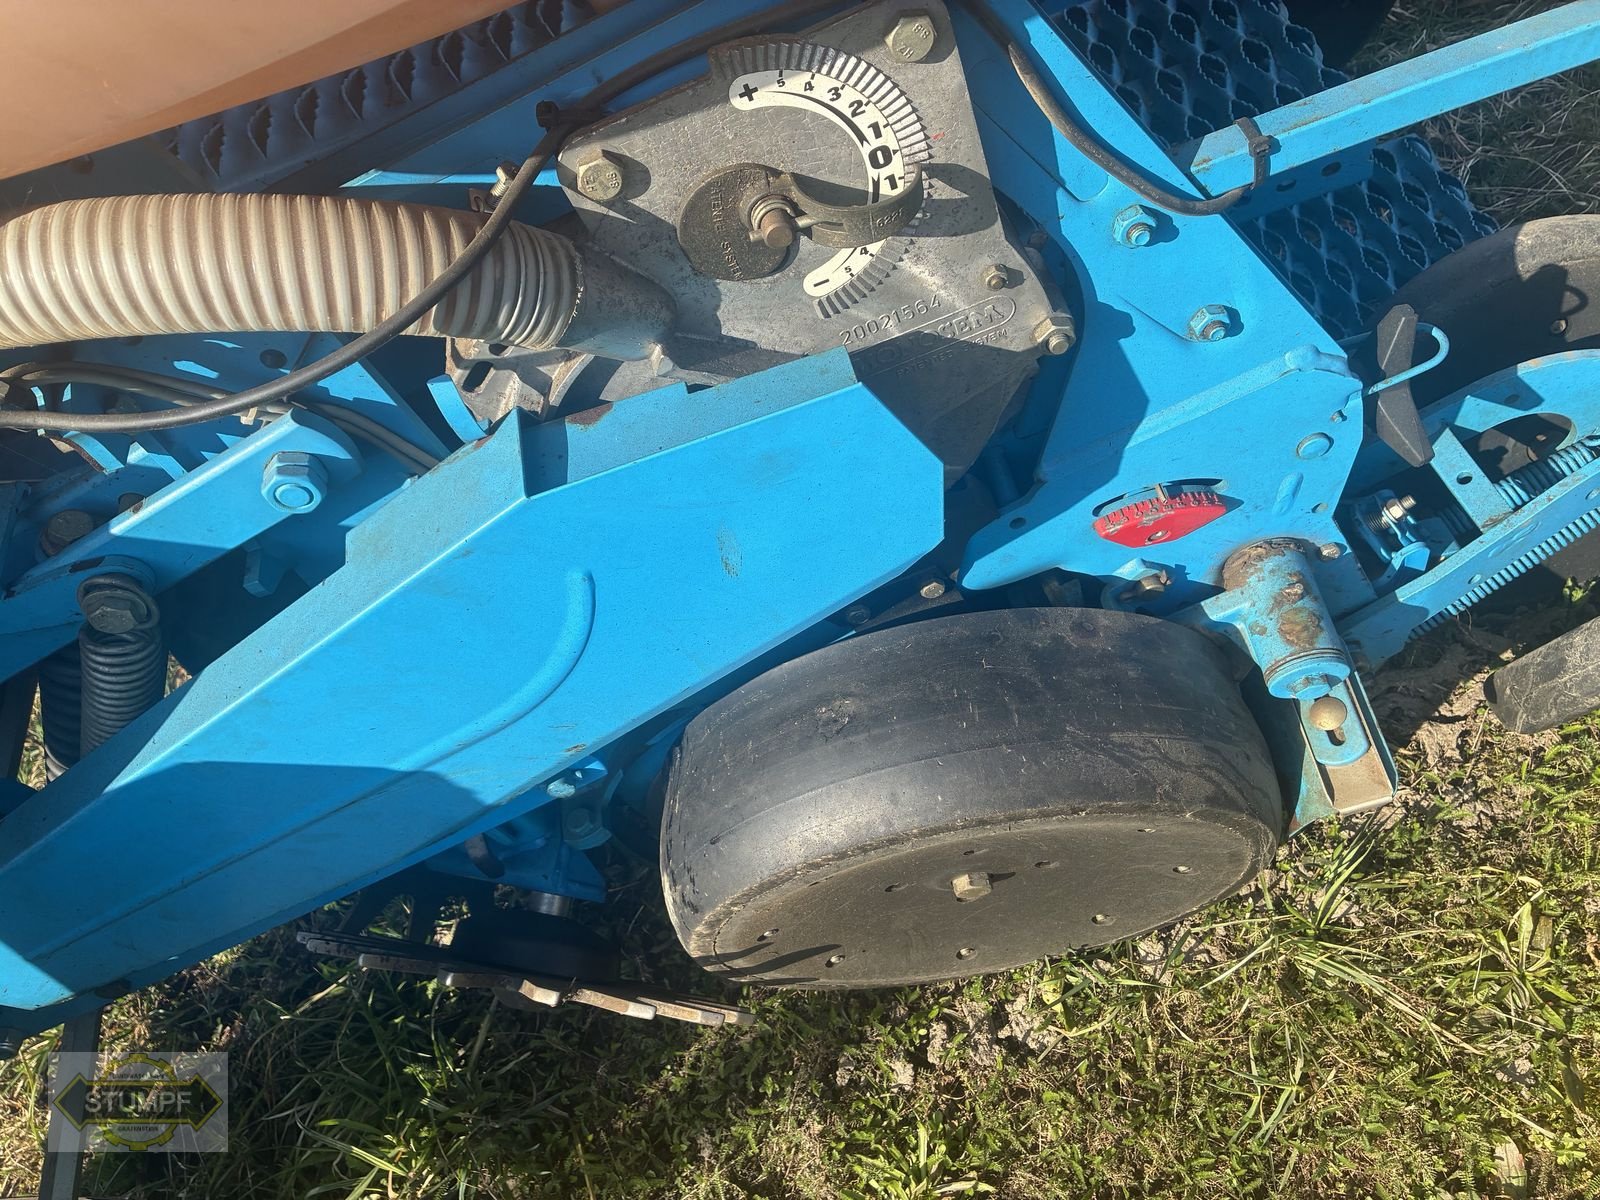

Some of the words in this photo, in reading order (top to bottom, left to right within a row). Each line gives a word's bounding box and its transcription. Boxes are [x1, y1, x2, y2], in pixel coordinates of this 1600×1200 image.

[776, 78, 786, 88] 5
[803, 81, 815, 92] 4
[827, 87, 842, 102] 3
[848, 99, 867, 118] 2
[867, 121, 882, 140] 1
[868, 145, 893, 170] 0
[883, 173, 898, 191] 1
[859, 246, 869, 256] 4
[844, 265, 852, 274] 5
[839, 294, 942, 346] 20021564
[962, 328, 1008, 352] SYSTEM
